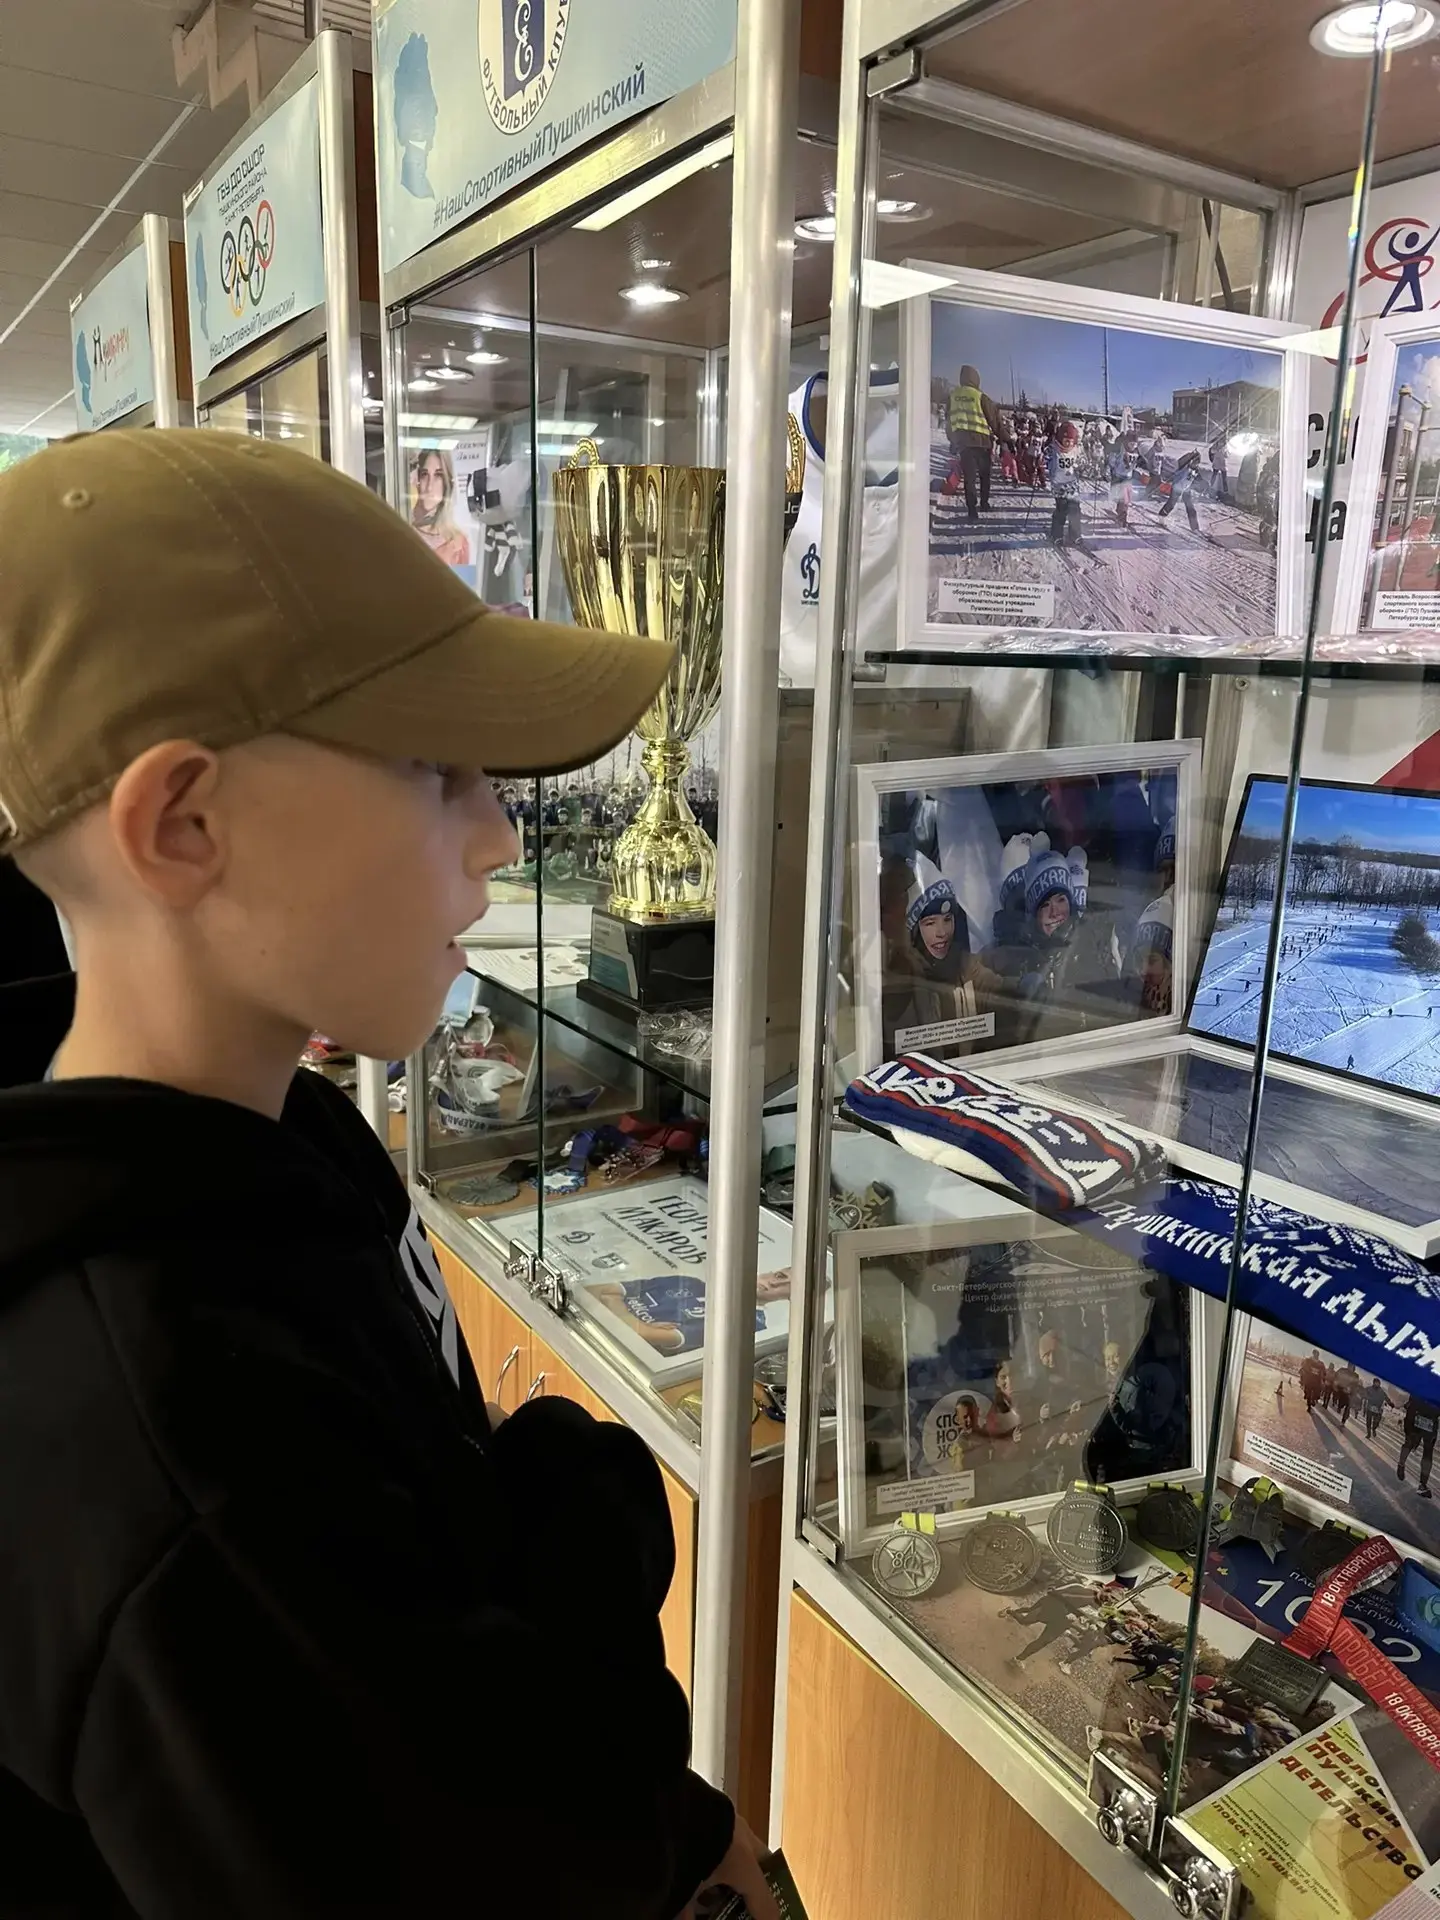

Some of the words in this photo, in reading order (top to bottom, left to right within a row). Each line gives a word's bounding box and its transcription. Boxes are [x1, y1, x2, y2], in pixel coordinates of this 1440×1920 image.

[483, 58, 548, 130] ФУТБОЛЬНЫЙ
[433, 62, 646, 229] #НашСпортивныйПушкинский
[614, 1206, 707, 1265] МАКАРОВ
[931, 1280, 1016, 1293] Санкт-Петербургское
[1320, 1590, 1337, 1607] 18
[1333, 1554, 1366, 1595] ОКТЯБРЯ
[1329, 1627, 1396, 1691] ПРОБЕГ
[1384, 1692, 1403, 1707] 18
[1397, 1702, 1440, 1751] ОКТЯБРЯ
[1278, 1755, 1425, 1880] ДЕТЕЛЬСТВО
[1258, 1847, 1309, 1895] ПУШКИН
